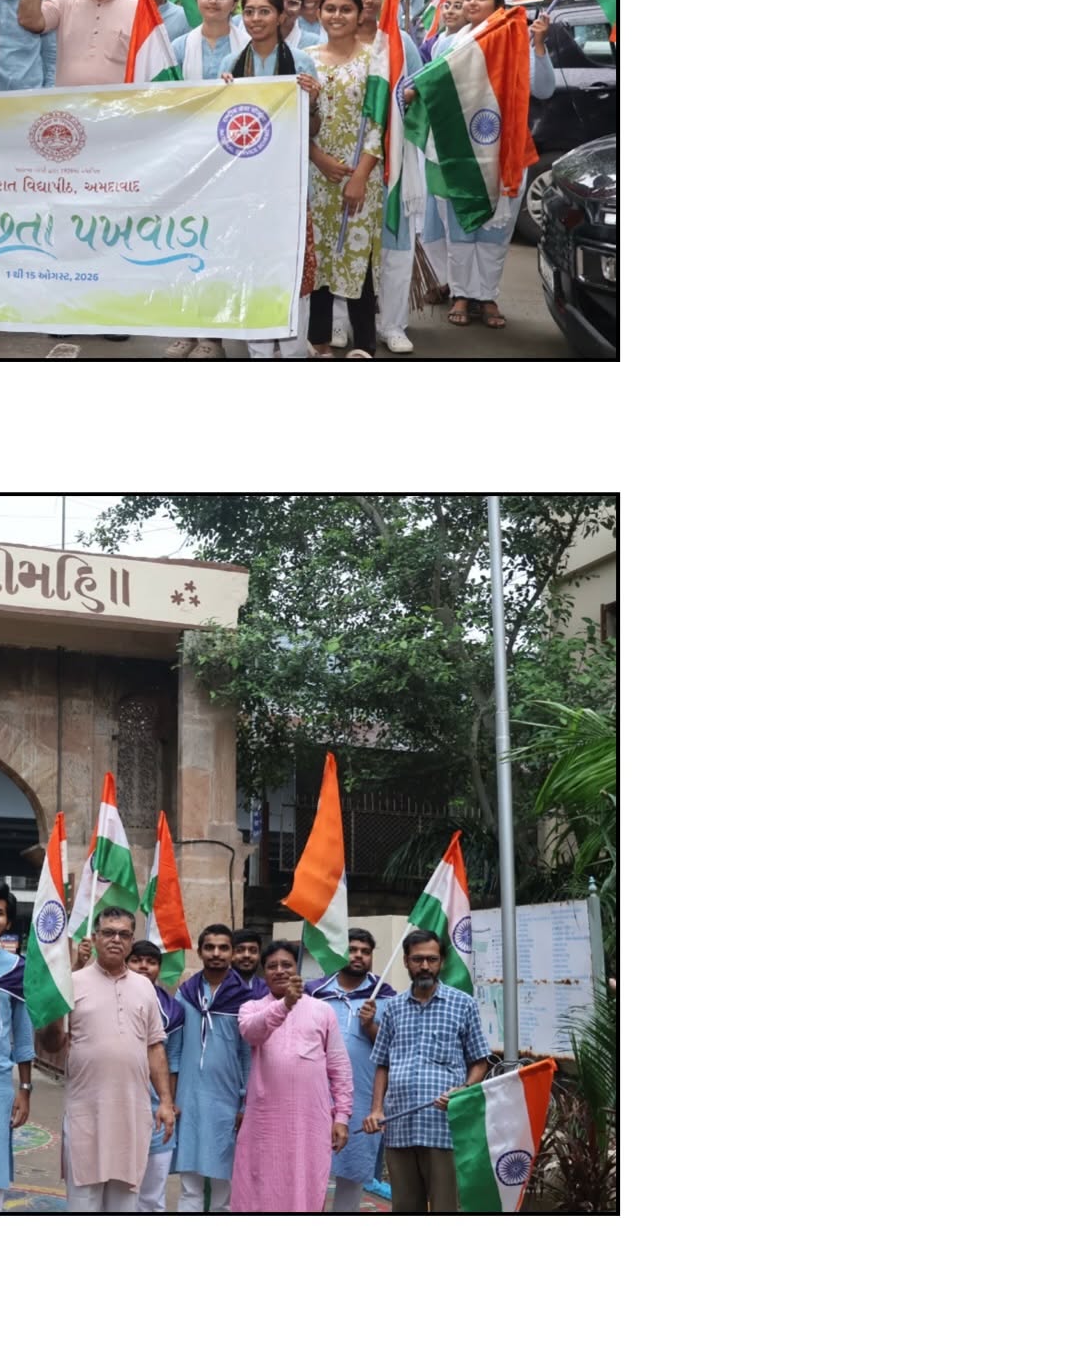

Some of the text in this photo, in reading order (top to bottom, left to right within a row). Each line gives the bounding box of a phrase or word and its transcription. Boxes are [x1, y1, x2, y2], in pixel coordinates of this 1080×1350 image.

[84, 180, 140, 193] અમદાવાદ
[70, 213, 211, 250] પખવાડા
[6, 270, 10, 279] 1
[13, 268, 24, 279] થી
[25, 270, 36, 280] 15
[74, 272, 99, 282] 2026
